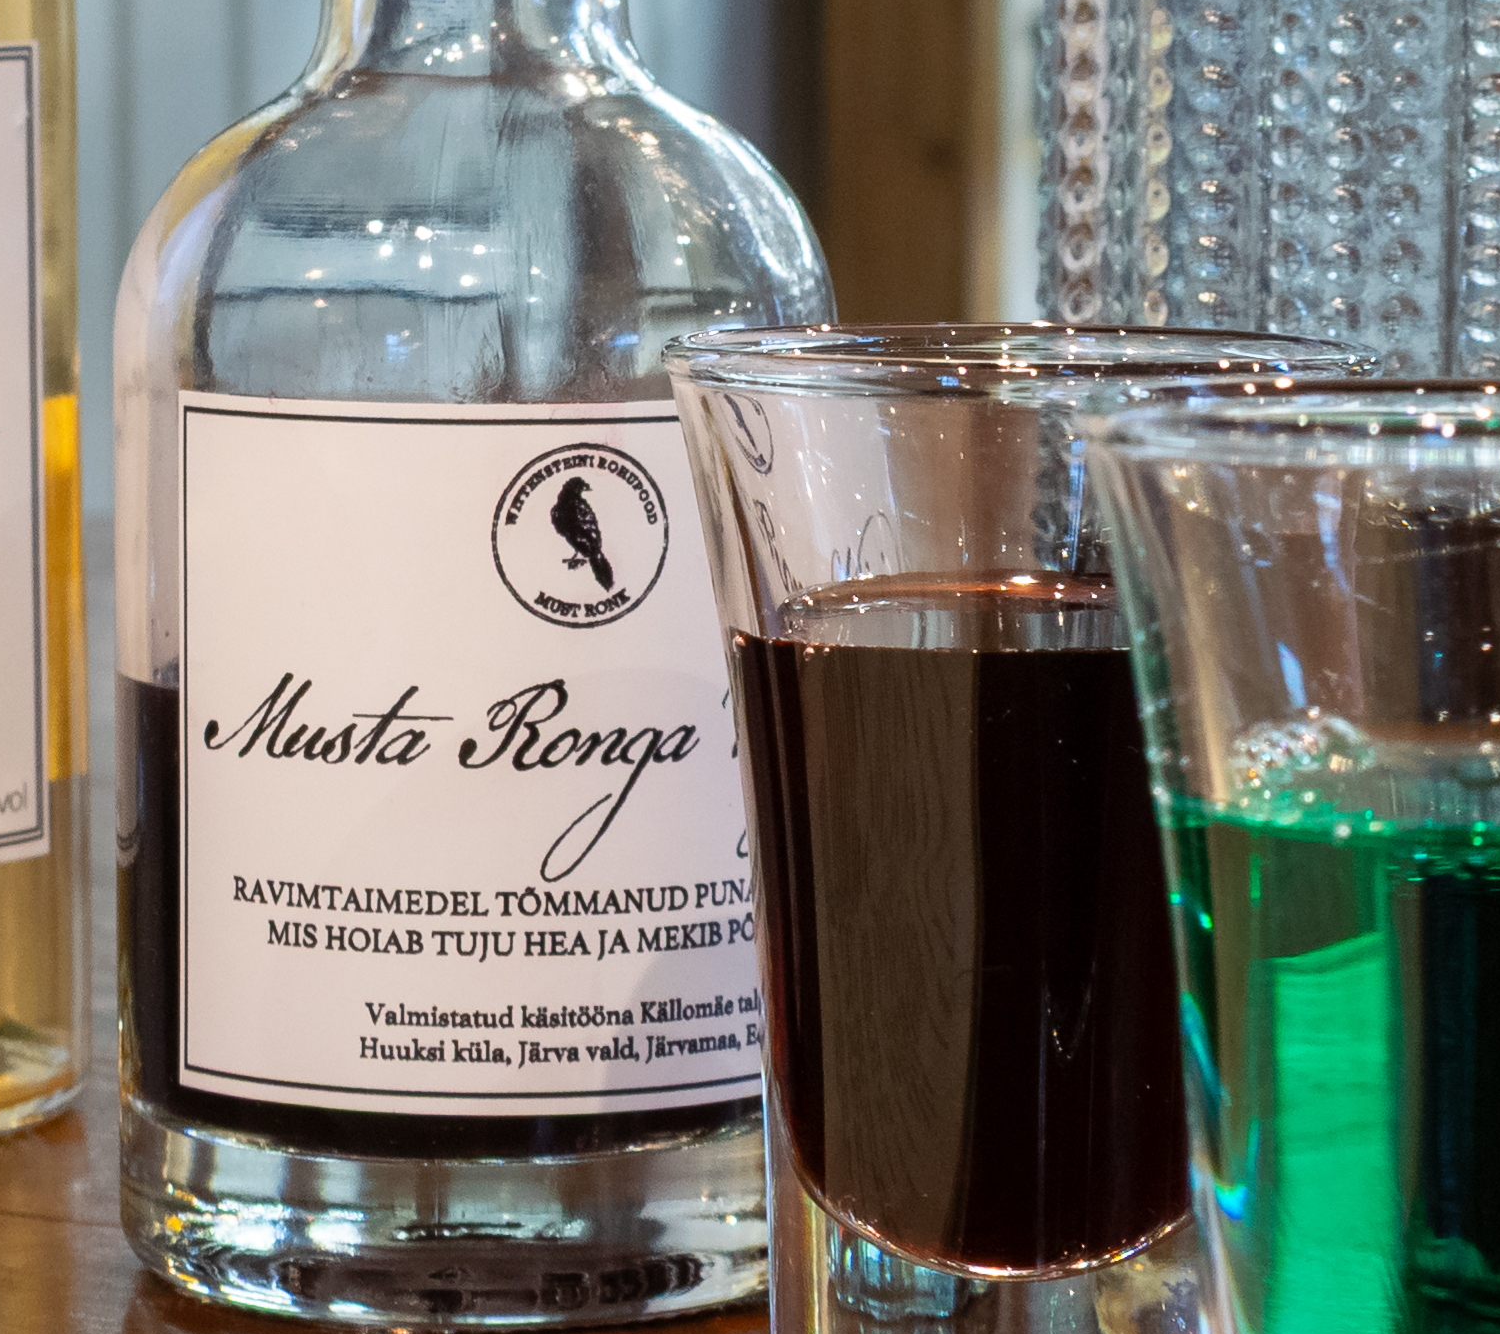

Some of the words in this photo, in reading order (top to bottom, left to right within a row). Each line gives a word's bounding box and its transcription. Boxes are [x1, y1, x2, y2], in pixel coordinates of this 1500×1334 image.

[534, 590, 582, 617] MUST
[584, 587, 631, 617] RONK
[203, 672, 454, 766] Musta
[459, 679, 700, 882] Ronga
[232, 875, 489, 917] RAVIMTAIMEDEL
[496, 881, 688, 917] TÕMMANUD
[267, 920, 319, 951] MIS
[325, 926, 424, 955] HOIAB
[434, 930, 516, 963] TUJU
[523, 929, 592, 957] HEA
[596, 926, 631, 961] JA
[637, 917, 724, 953] MEKIB
[365, 1001, 514, 1030] Valmistatud
[521, 998, 635, 1028] käsitööna
[640, 993, 735, 1027] Källomäe
[359, 1036, 447, 1063] Huuksi
[452, 1037, 512, 1068] küla,
[517, 1037, 580, 1069] Järva
[586, 1033, 640, 1064] vald,
[645, 1030, 742, 1065] Järvamaa,
